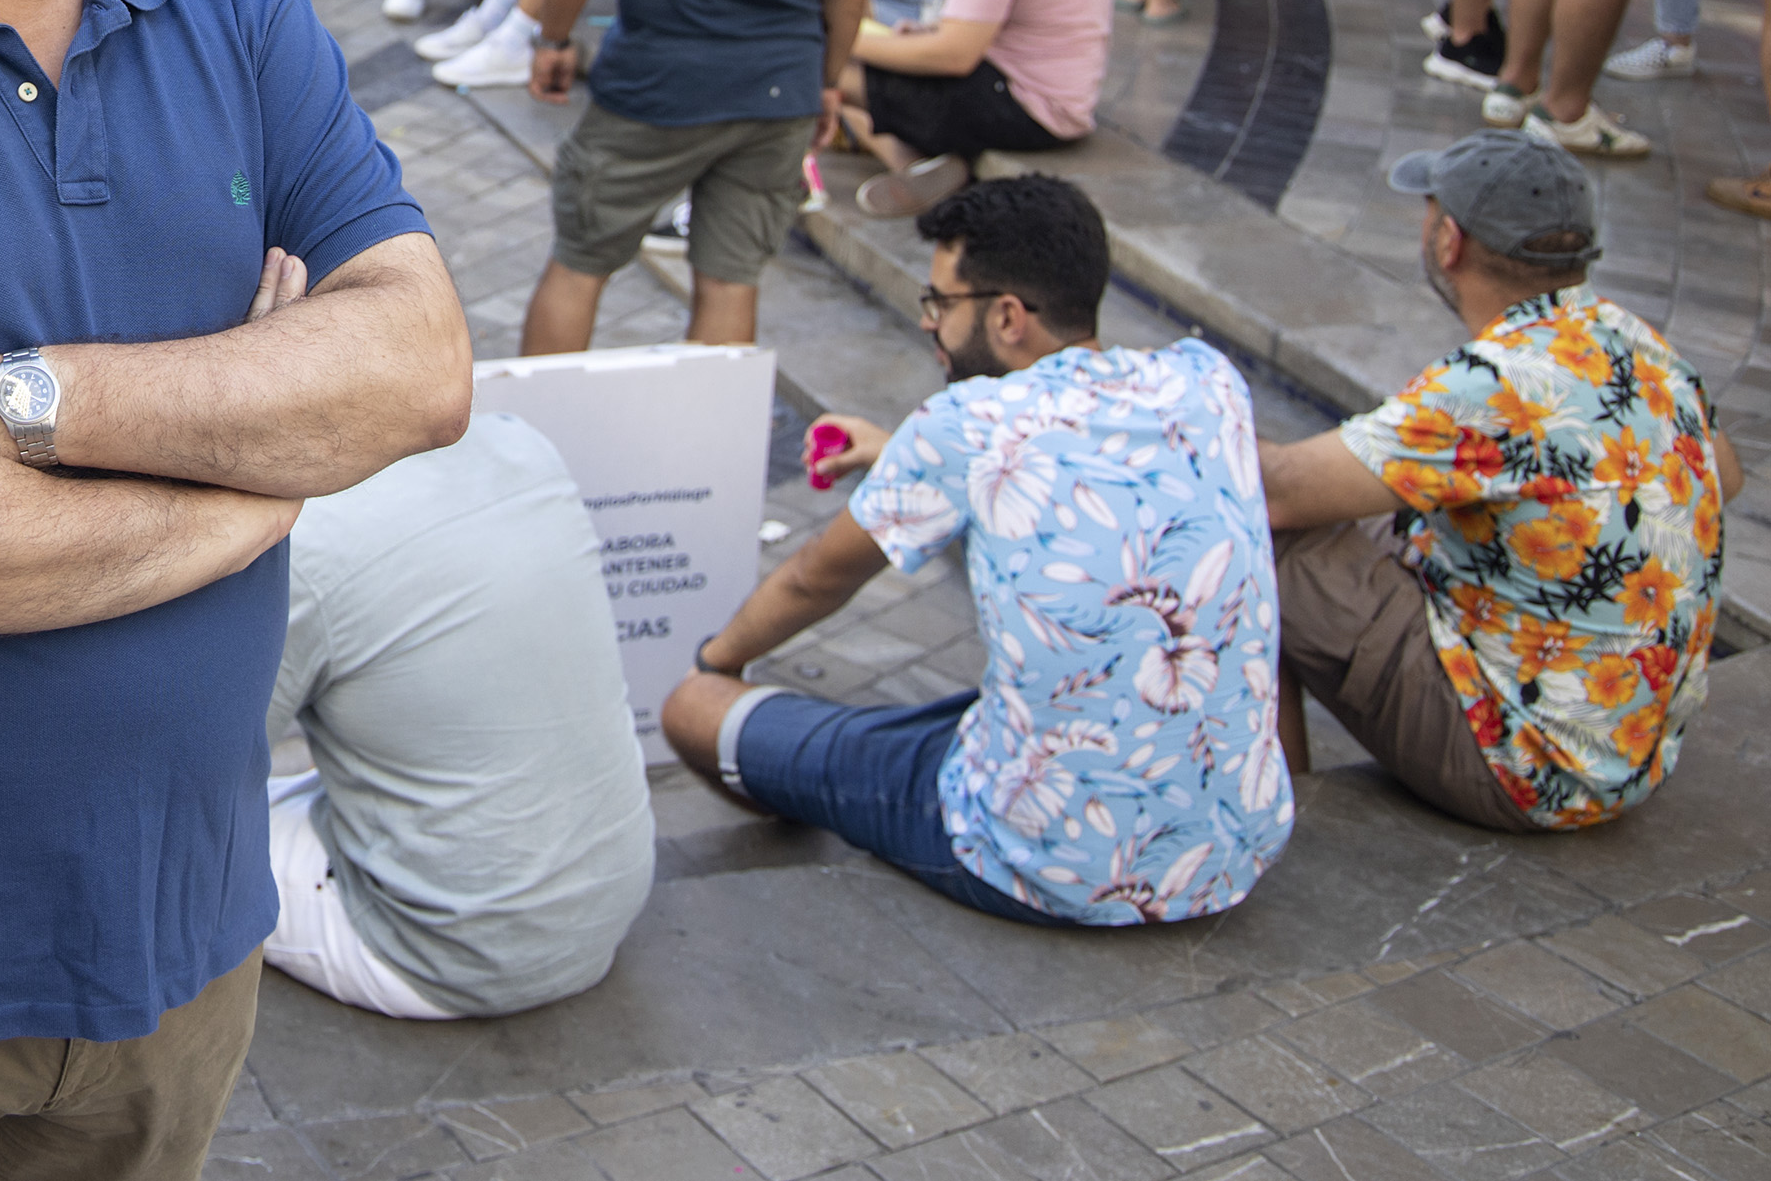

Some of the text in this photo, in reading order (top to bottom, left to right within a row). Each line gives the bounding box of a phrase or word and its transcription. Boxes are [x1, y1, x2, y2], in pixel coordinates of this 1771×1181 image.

[600, 533, 675, 555] ABORA
[602, 553, 691, 576] ANTENER
[607, 572, 708, 600] U CIUDAD
[616, 616, 671, 643] CIAS
